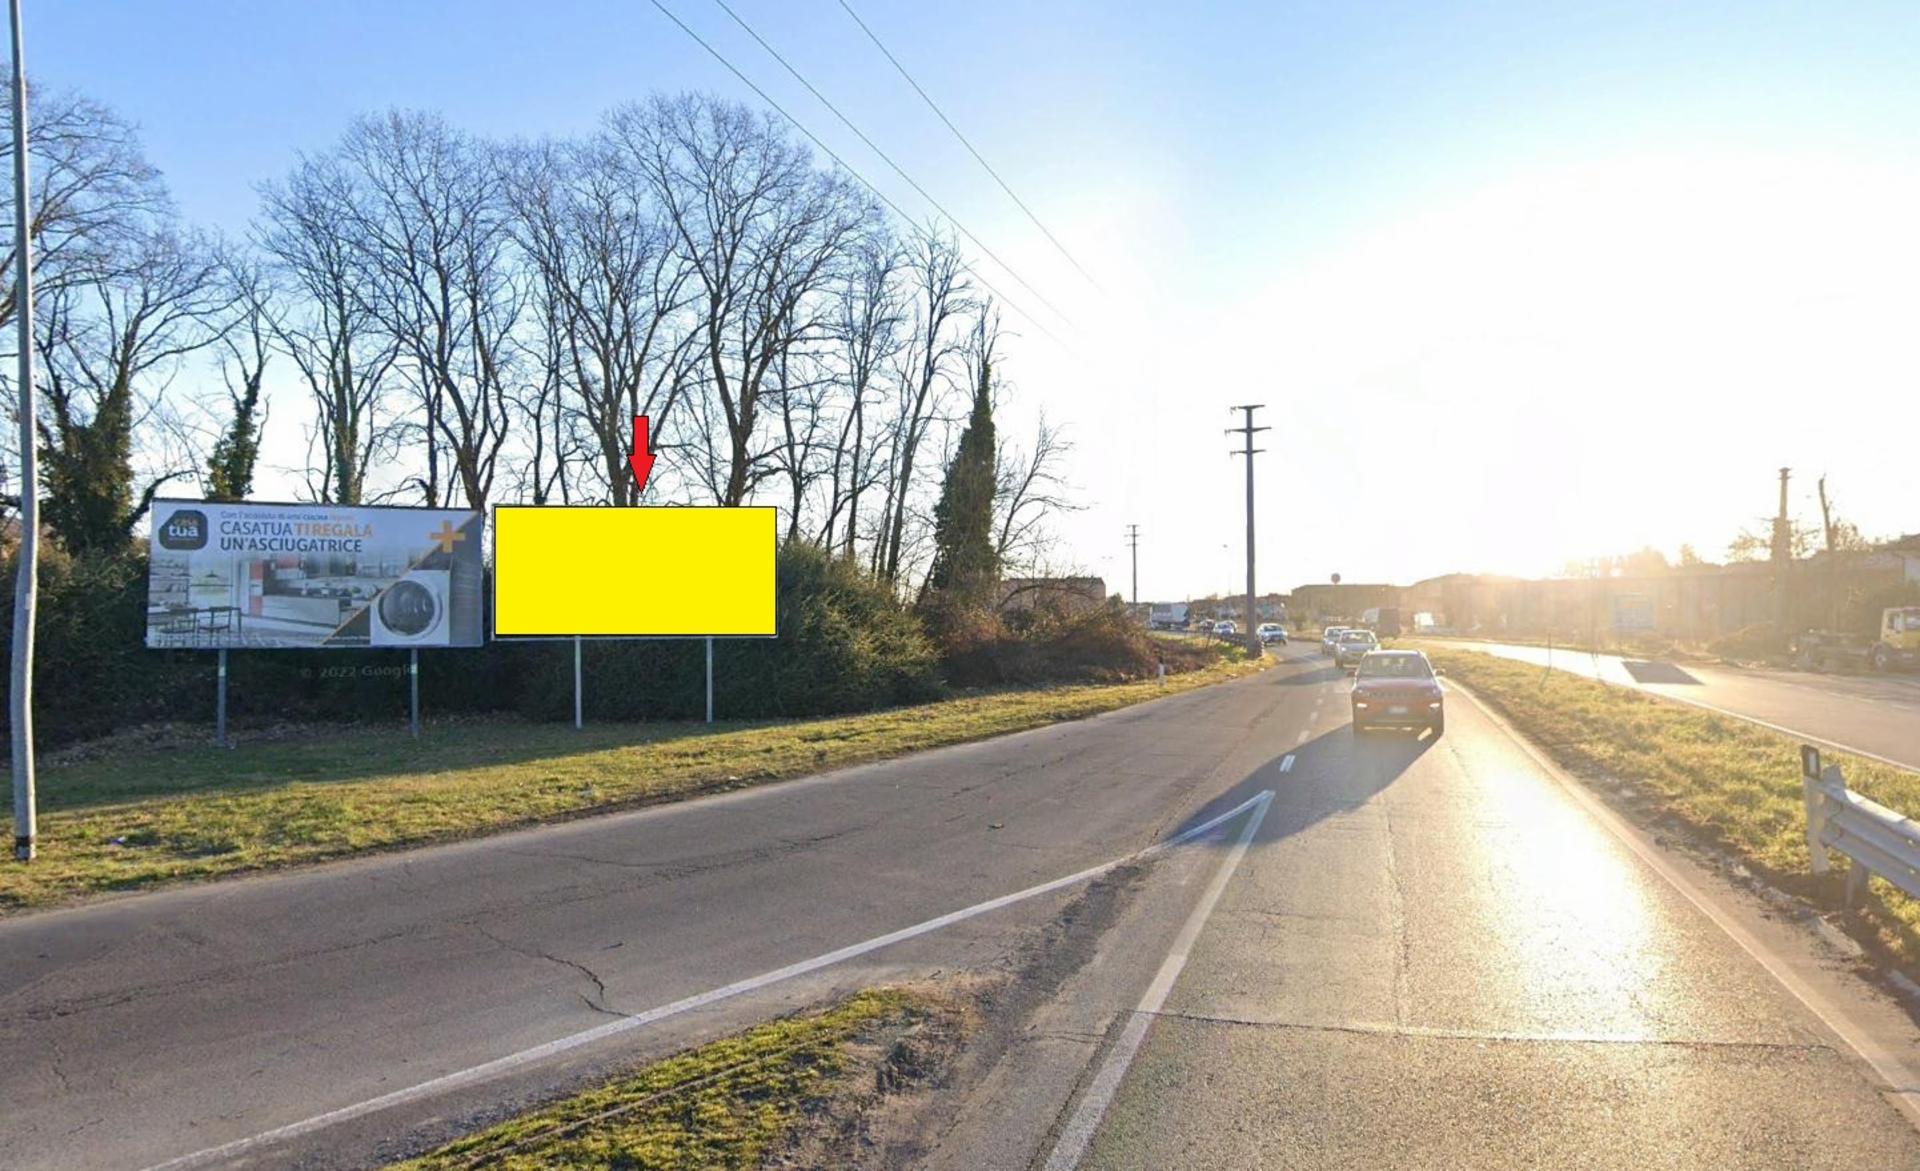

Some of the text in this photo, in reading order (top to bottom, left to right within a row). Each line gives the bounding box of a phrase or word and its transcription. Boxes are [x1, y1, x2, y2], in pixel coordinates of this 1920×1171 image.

[168, 524, 199, 538] tua
[220, 520, 294, 537] CASATUA
[220, 537, 363, 553] UN'ASCIUGATRICE
